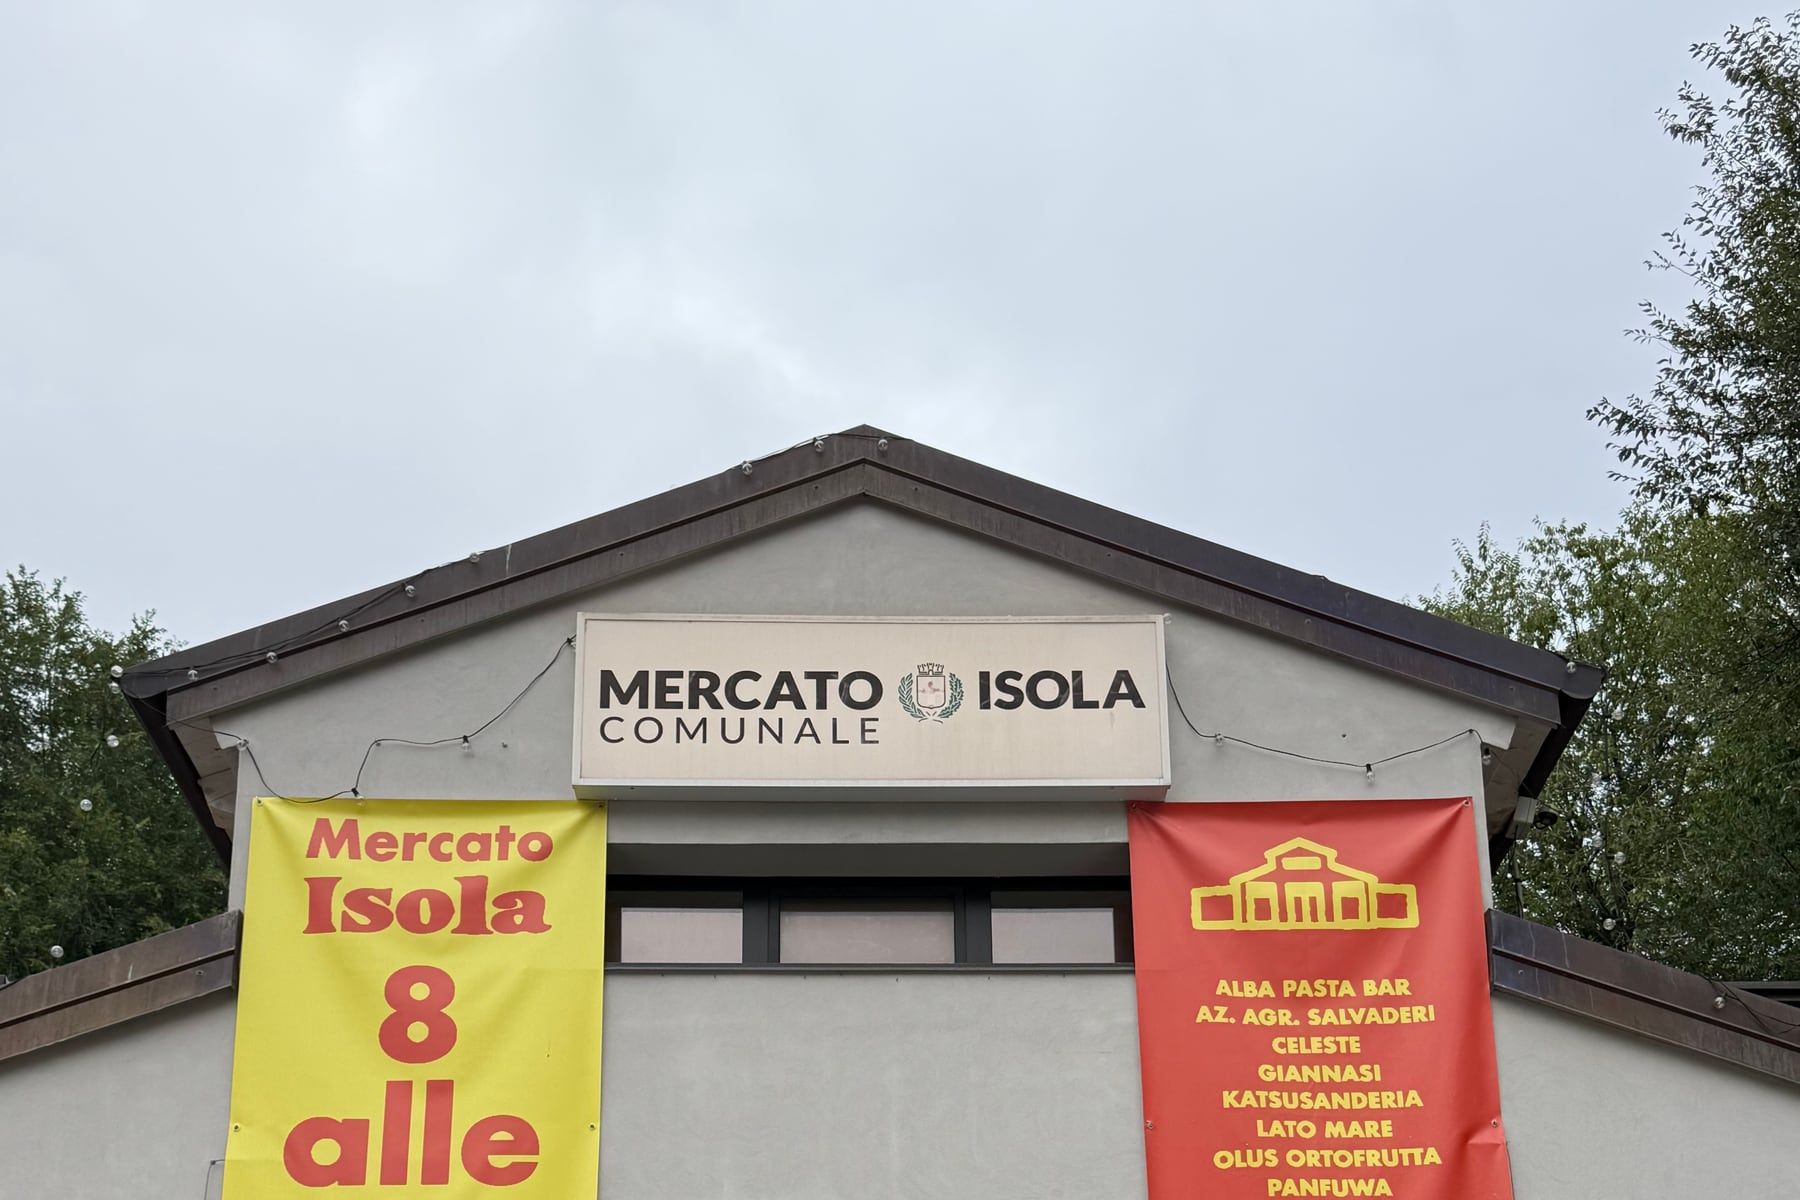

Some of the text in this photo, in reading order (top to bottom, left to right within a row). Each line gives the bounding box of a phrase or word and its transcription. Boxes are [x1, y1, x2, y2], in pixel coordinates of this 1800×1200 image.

[600, 670, 1145, 710] MERCATO ISOLA
[600, 717, 879, 744] COMUNALE
[306, 812, 553, 862] Mercato
[303, 875, 552, 935] Isola
[1216, 979, 1412, 997] ALBA PASTA BAR
[379, 965, 457, 1064] 8
[1196, 1005, 1435, 1026] AZ. AGR. SALVADERI
[1272, 1036, 1360, 1054] CELESTE
[1258, 1064, 1381, 1082] GIANNASI
[1223, 1090, 1423, 1109] KATSUSANDERIA
[284, 1080, 539, 1187] alle
[1257, 1120, 1393, 1138] LATO MARE
[1213, 1147, 1442, 1169] OLUS ORTOFRUTTA
[1268, 1179, 1393, 1197] PANFUWA
